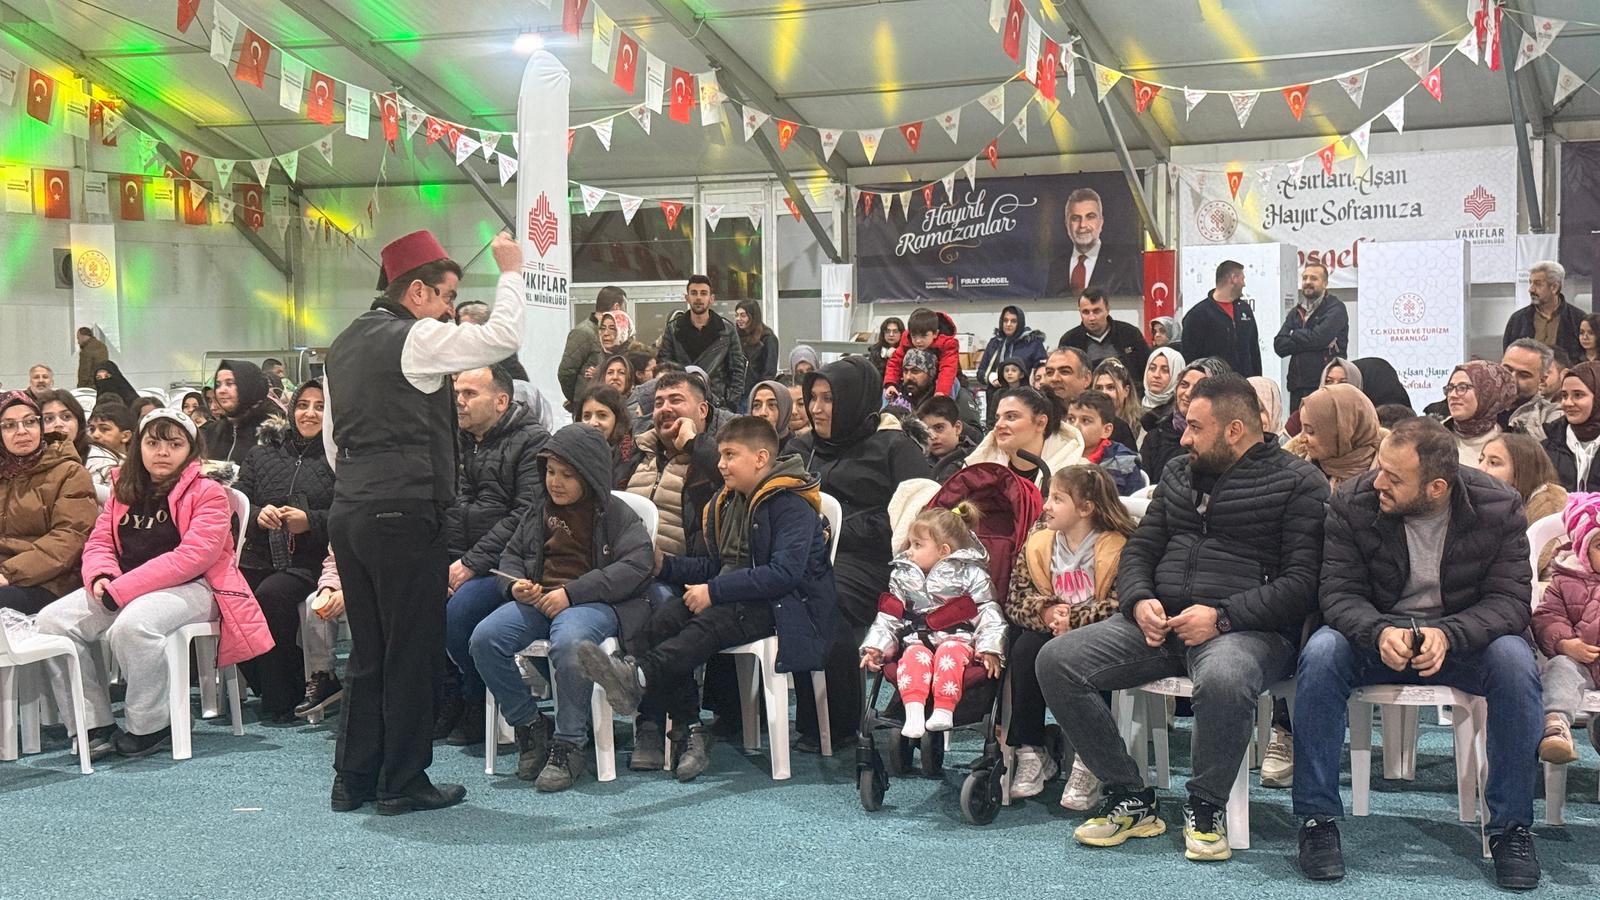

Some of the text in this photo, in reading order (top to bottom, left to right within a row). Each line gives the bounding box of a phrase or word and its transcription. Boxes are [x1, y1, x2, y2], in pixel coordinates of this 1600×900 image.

[1353, 164, 1408, 196] Aşan
[895, 194, 1036, 257] Ramazanlar
[922, 189, 986, 232] Hayırlı
[1262, 198, 1424, 232] Hayır Soframıza
[1455, 228, 1504, 239] VAKIFLAR
[1383, 327, 1410, 335] KÜLTÜR
